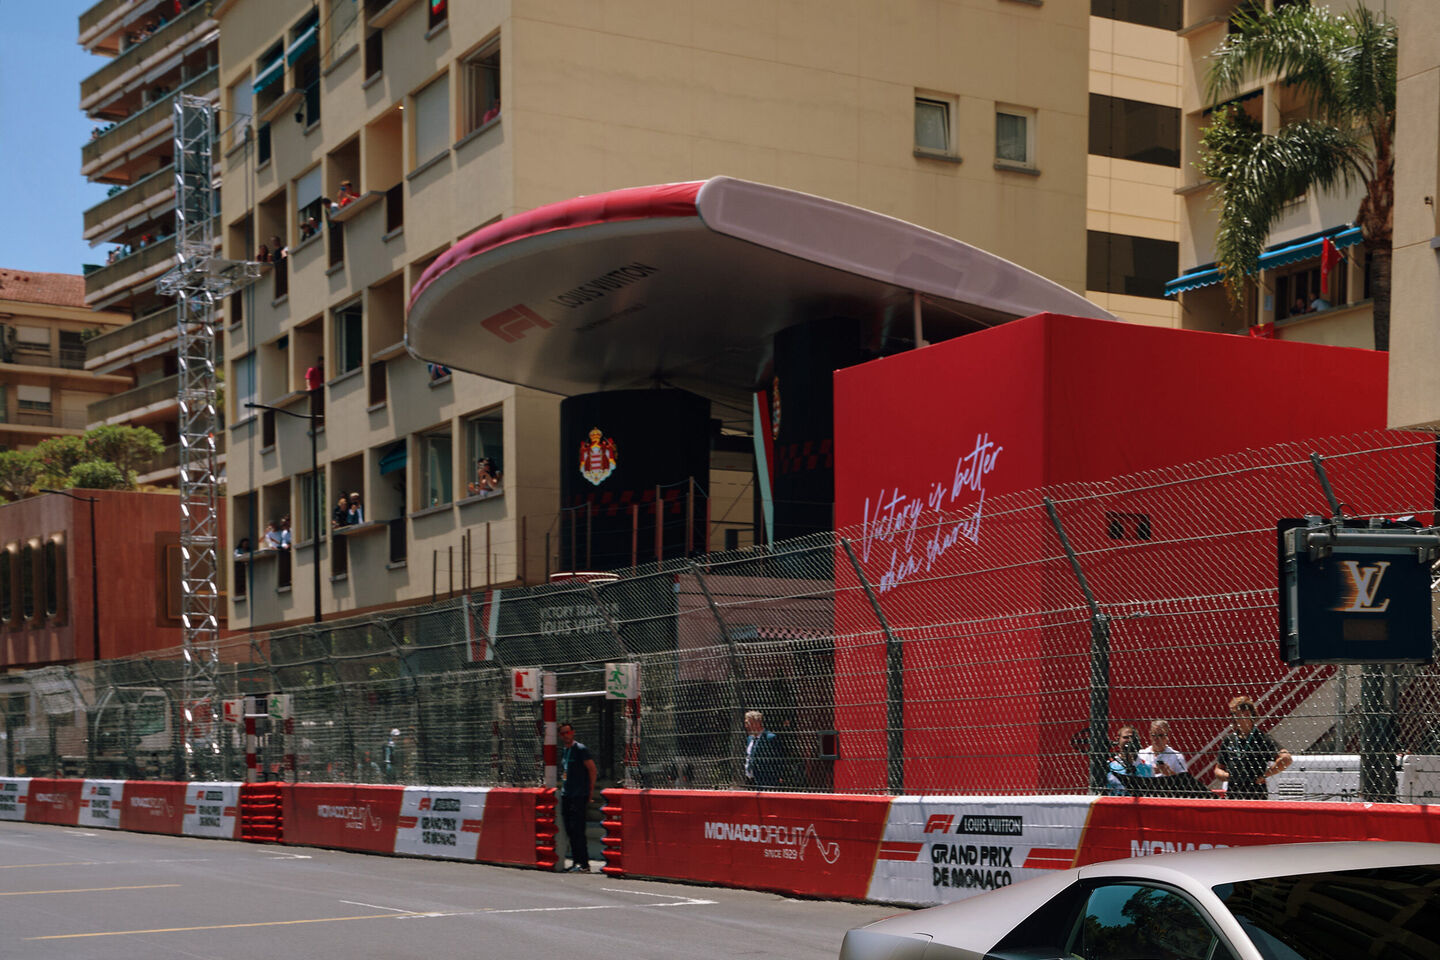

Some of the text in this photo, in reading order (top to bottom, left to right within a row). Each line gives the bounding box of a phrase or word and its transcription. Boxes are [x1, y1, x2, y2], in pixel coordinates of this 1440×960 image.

[863, 433, 1003, 563] Victory is better
[880, 488, 985, 593] when shared
[923, 814, 955, 834] F1
[964, 818, 1021, 833] LOUIS VUITTON
[764, 848, 782, 859] SINCE
[931, 843, 1013, 868] GRAND PRIX
[932, 866, 1012, 890] DE MONACO
